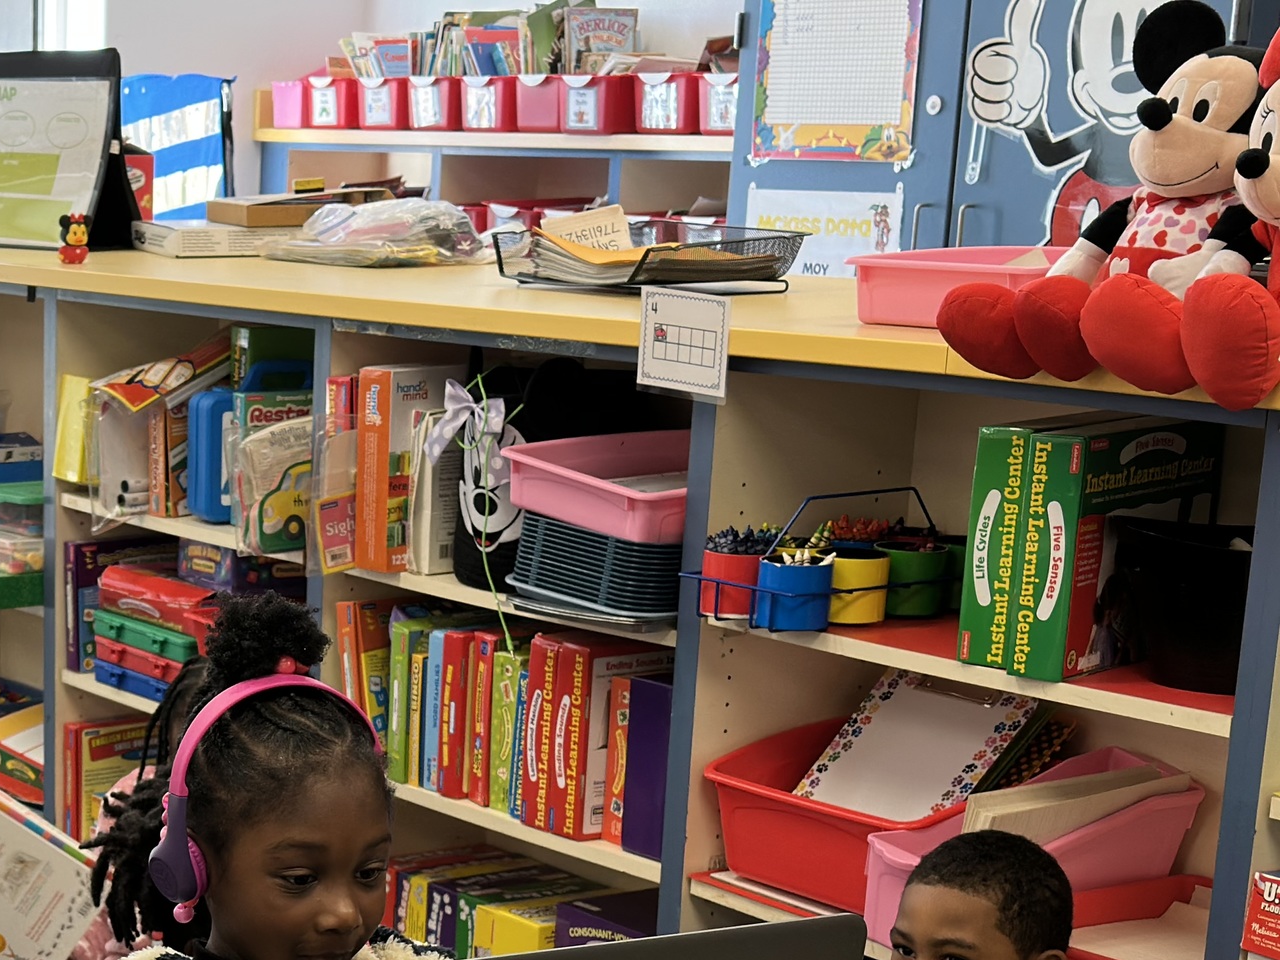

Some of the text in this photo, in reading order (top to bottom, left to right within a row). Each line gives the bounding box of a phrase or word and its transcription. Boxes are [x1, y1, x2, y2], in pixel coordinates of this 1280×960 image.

[803, 263, 829, 275] MOY
[651, 302, 658, 314] 4
[1085, 468, 1127, 493] Instant
[1129, 459, 1179, 484] Learning
[1181, 456, 1215, 475] Center
[976, 515, 990, 579] Life Cycles
[987, 436, 1024, 664] Instant Learning Center
[1013, 442, 1052, 673] Instant Learning Center
[1046, 525, 1062, 599] Five Senses
[606, 657, 664, 671] Ending Sounds
[531, 692, 541, 723] Matching
[557, 703, 568, 740] Sounds
[535, 649, 555, 828] Instant Learning Center
[564, 653, 583, 834] Instant Learning Center
